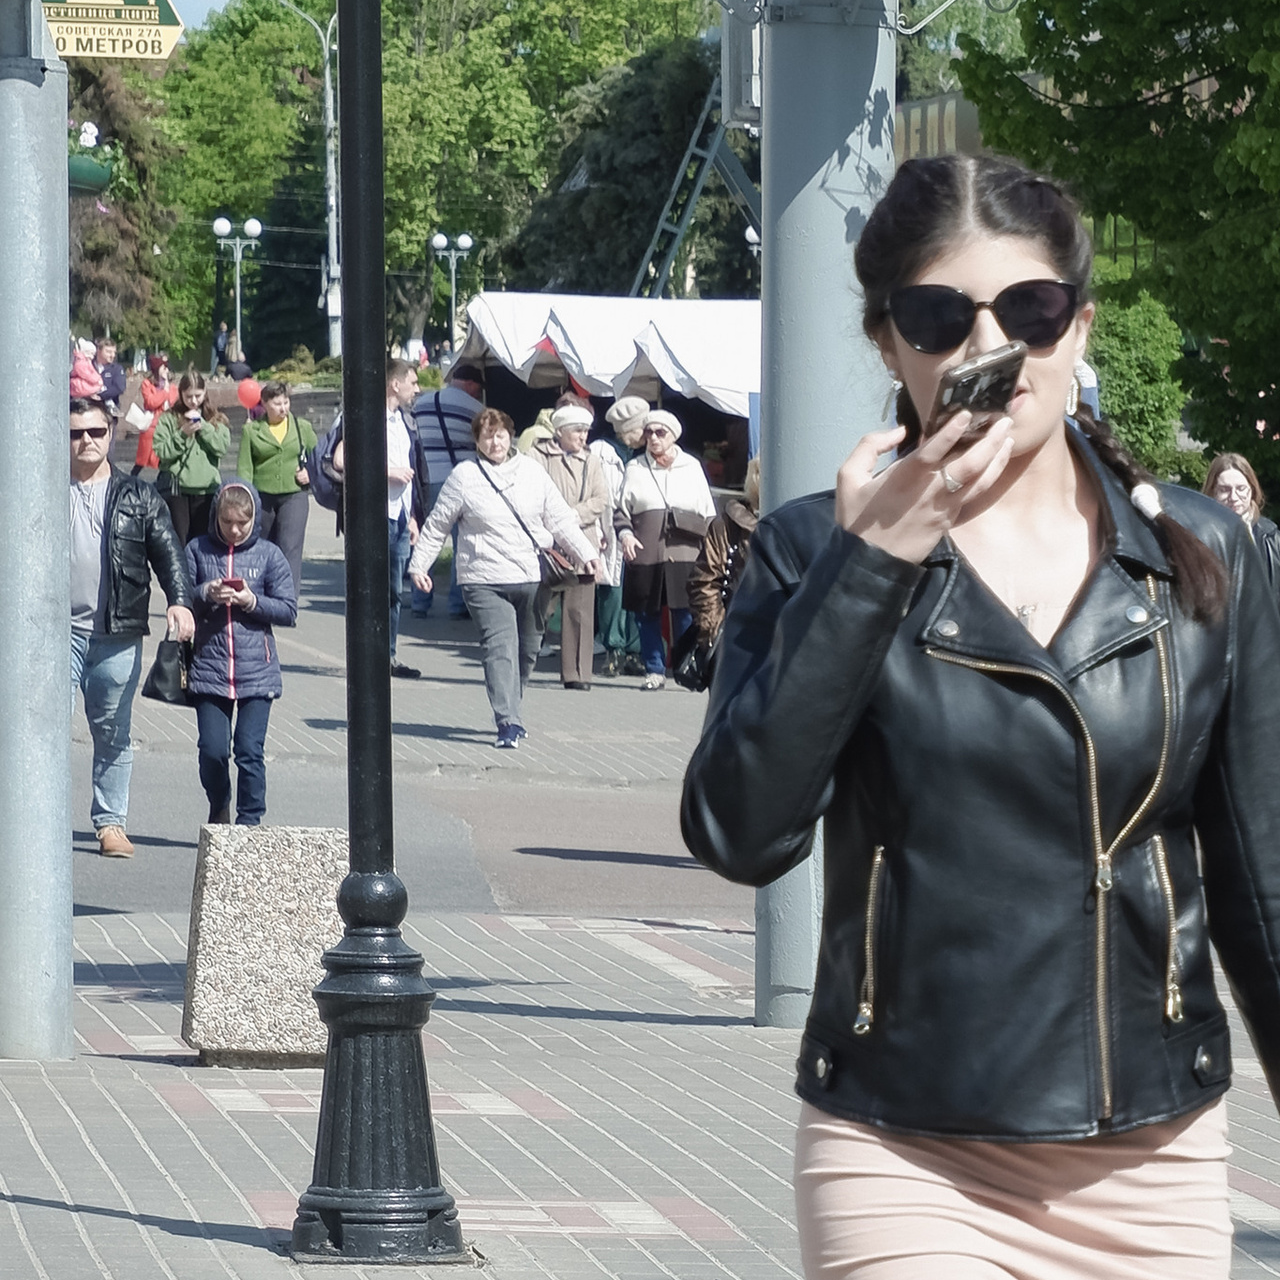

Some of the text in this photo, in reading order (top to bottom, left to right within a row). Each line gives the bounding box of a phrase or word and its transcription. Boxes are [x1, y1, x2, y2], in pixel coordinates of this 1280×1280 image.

[57, 25, 162, 38] СОВЕТСКАЯ 27А
[75, 37, 163, 55] МЕТРОВ
